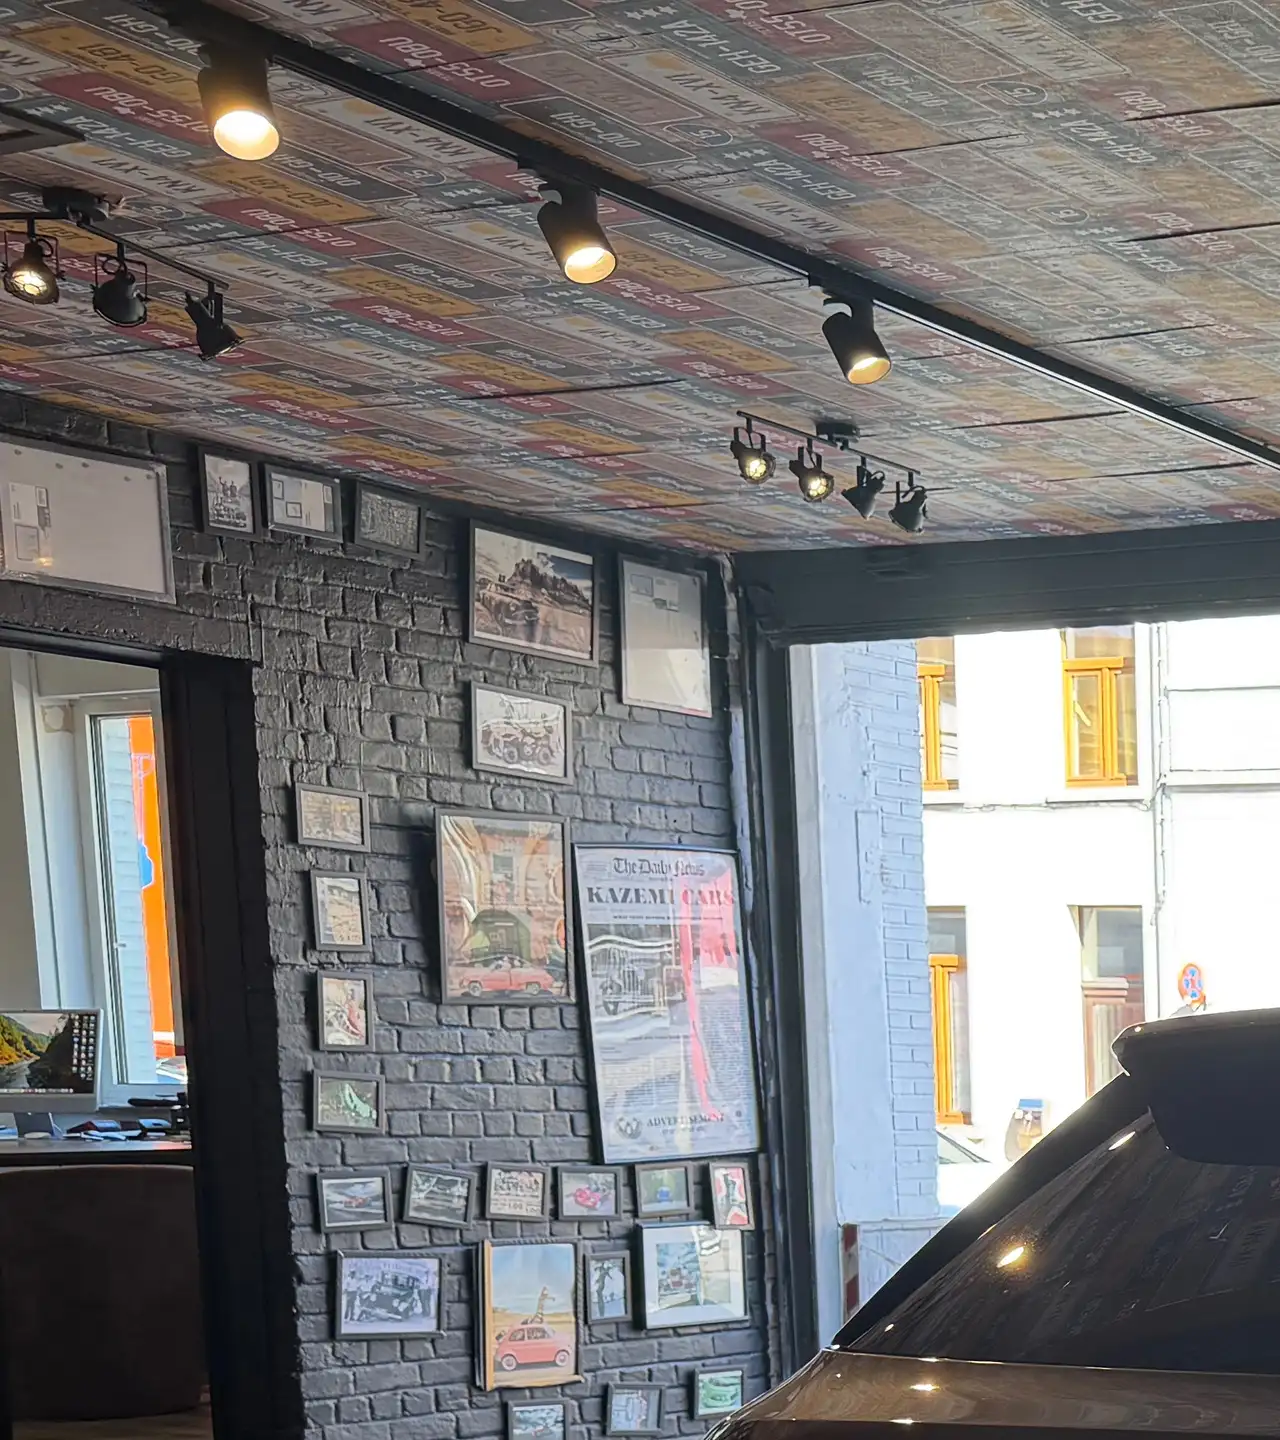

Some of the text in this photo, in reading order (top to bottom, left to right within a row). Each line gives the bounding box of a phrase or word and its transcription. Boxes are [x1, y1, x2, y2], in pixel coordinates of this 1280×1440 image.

[613, 857, 637, 875] The
[587, 886, 735, 908] KAZEMI CARS
